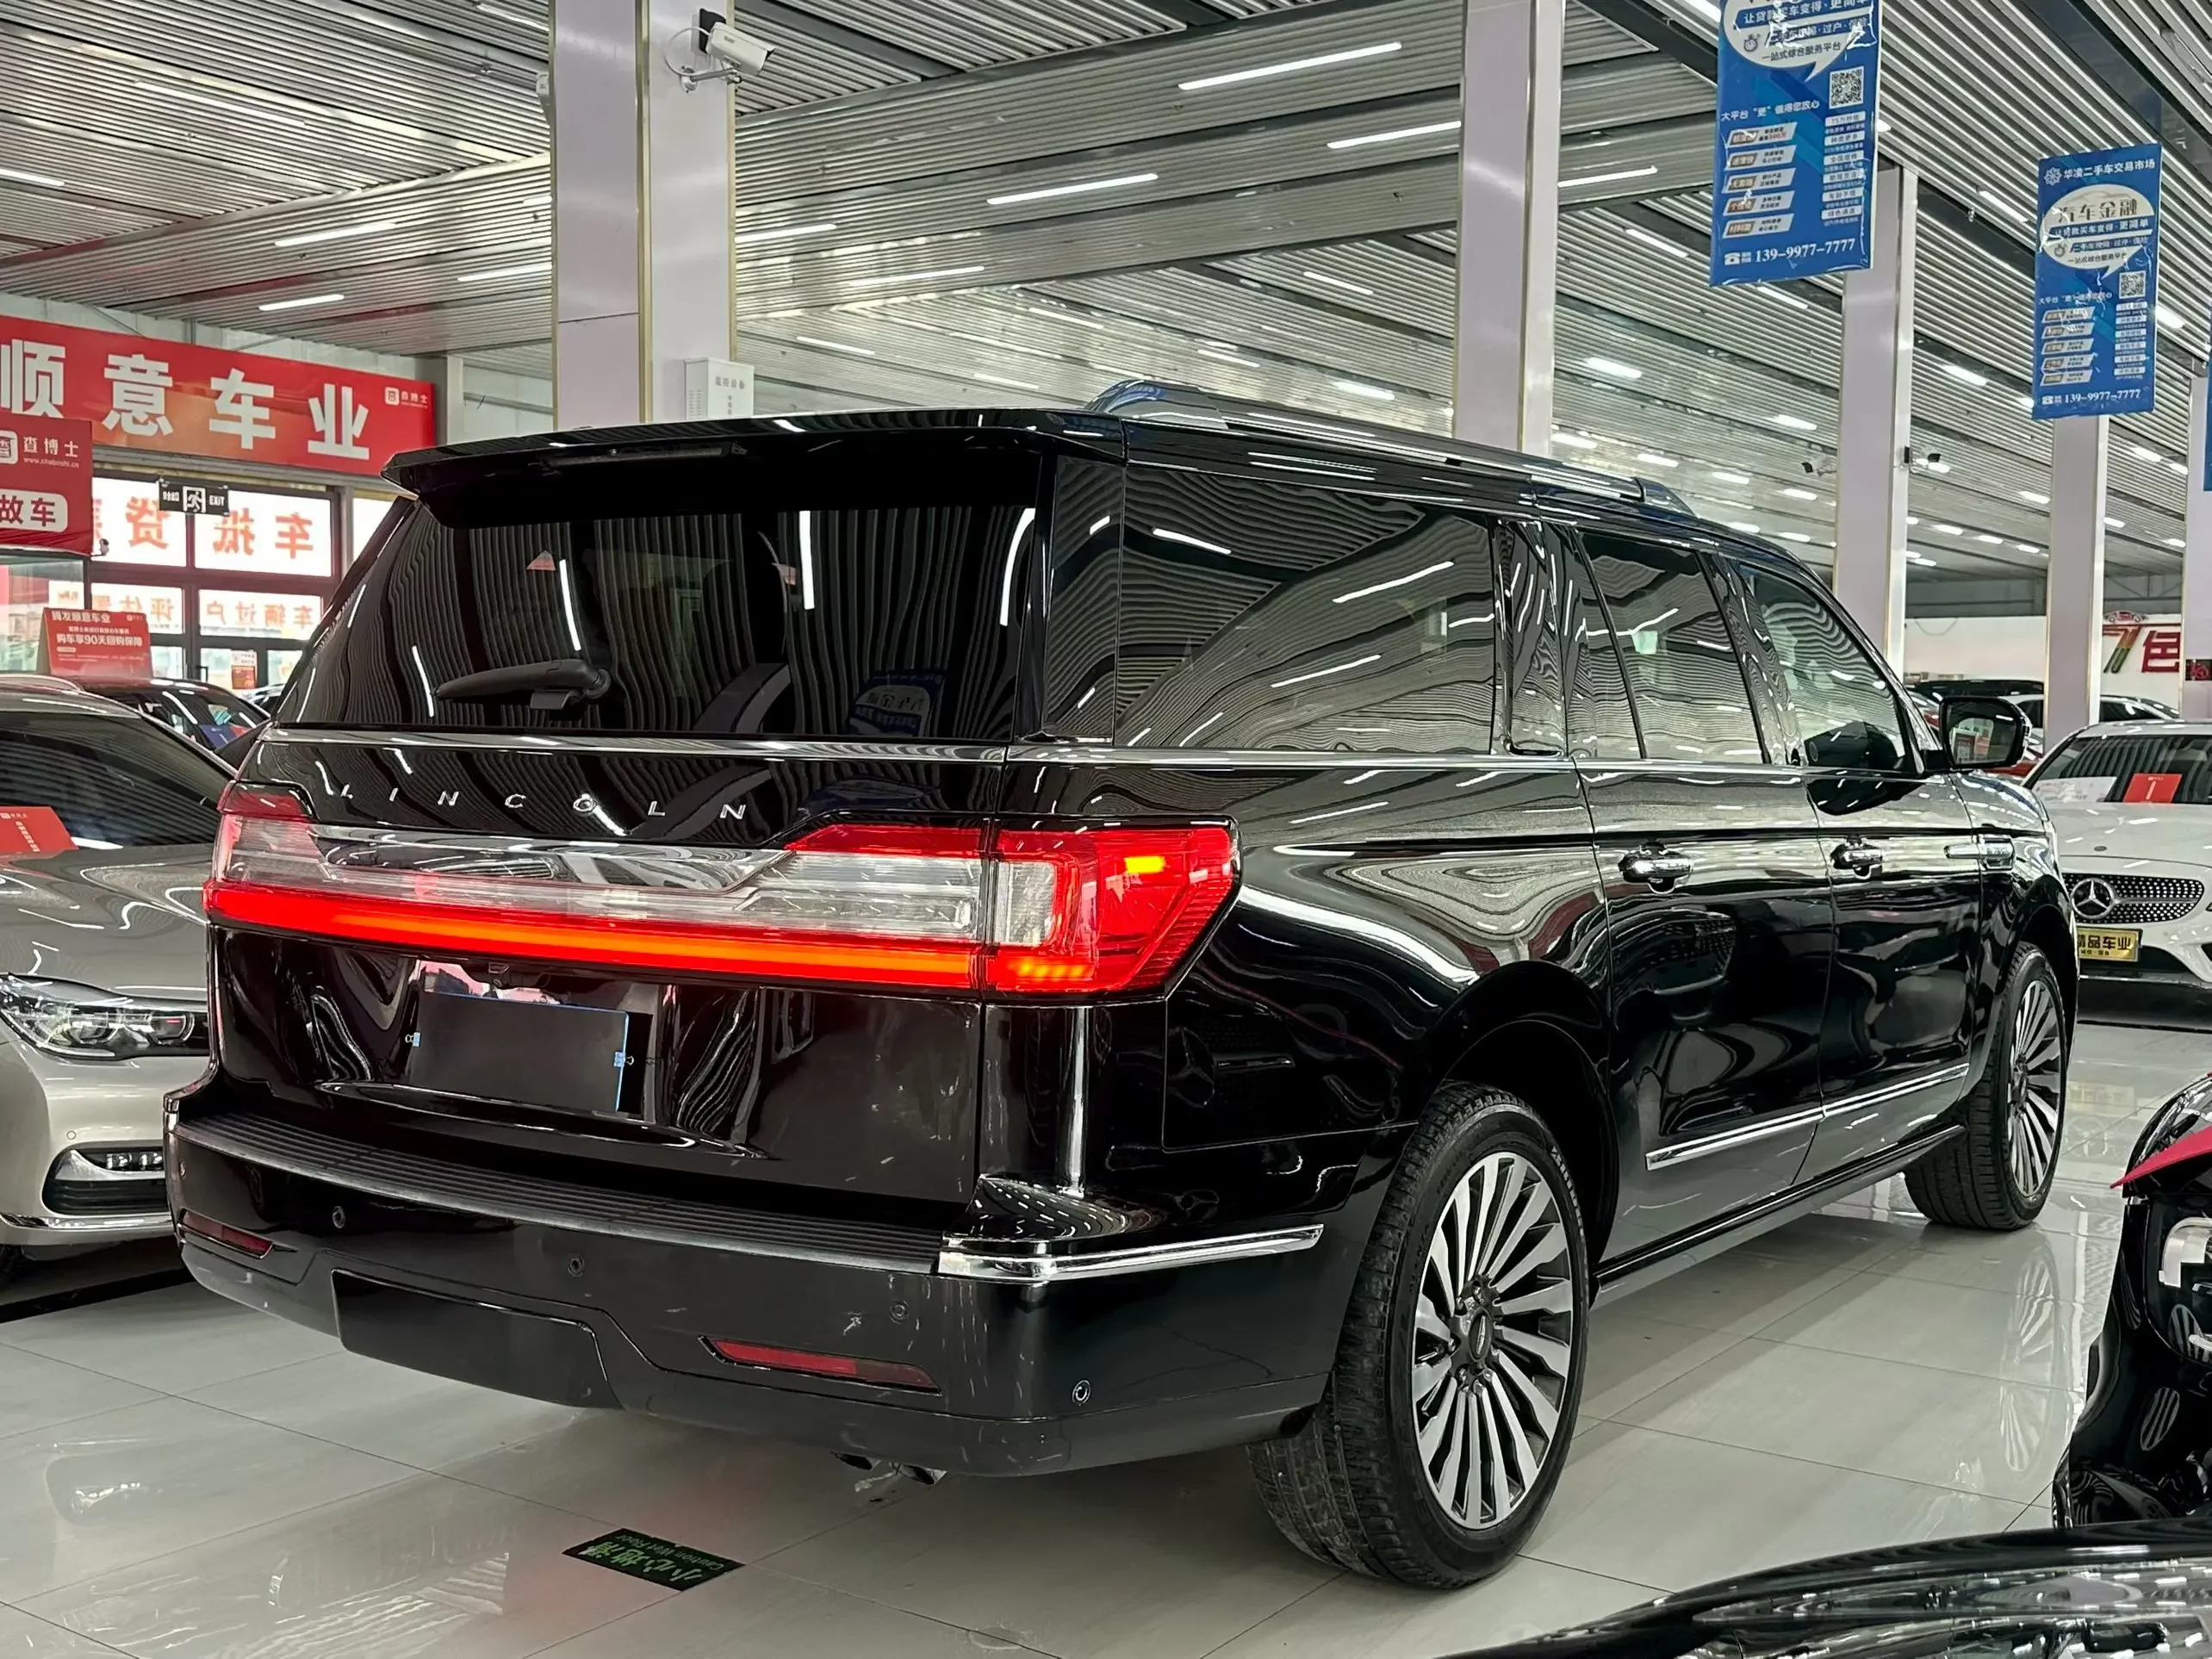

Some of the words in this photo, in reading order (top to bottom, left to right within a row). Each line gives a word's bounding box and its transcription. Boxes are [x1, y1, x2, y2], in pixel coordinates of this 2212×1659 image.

[1754, 238, 1856, 263] 139-9977-7777
[0, 339, 370, 461] 顺意车业
[23, 436, 79, 458] 查博士
[209, 494, 225, 506] EXIT
[340, 784, 746, 820] LINCOLN
[577, 1541, 703, 1582] 小心地滑
